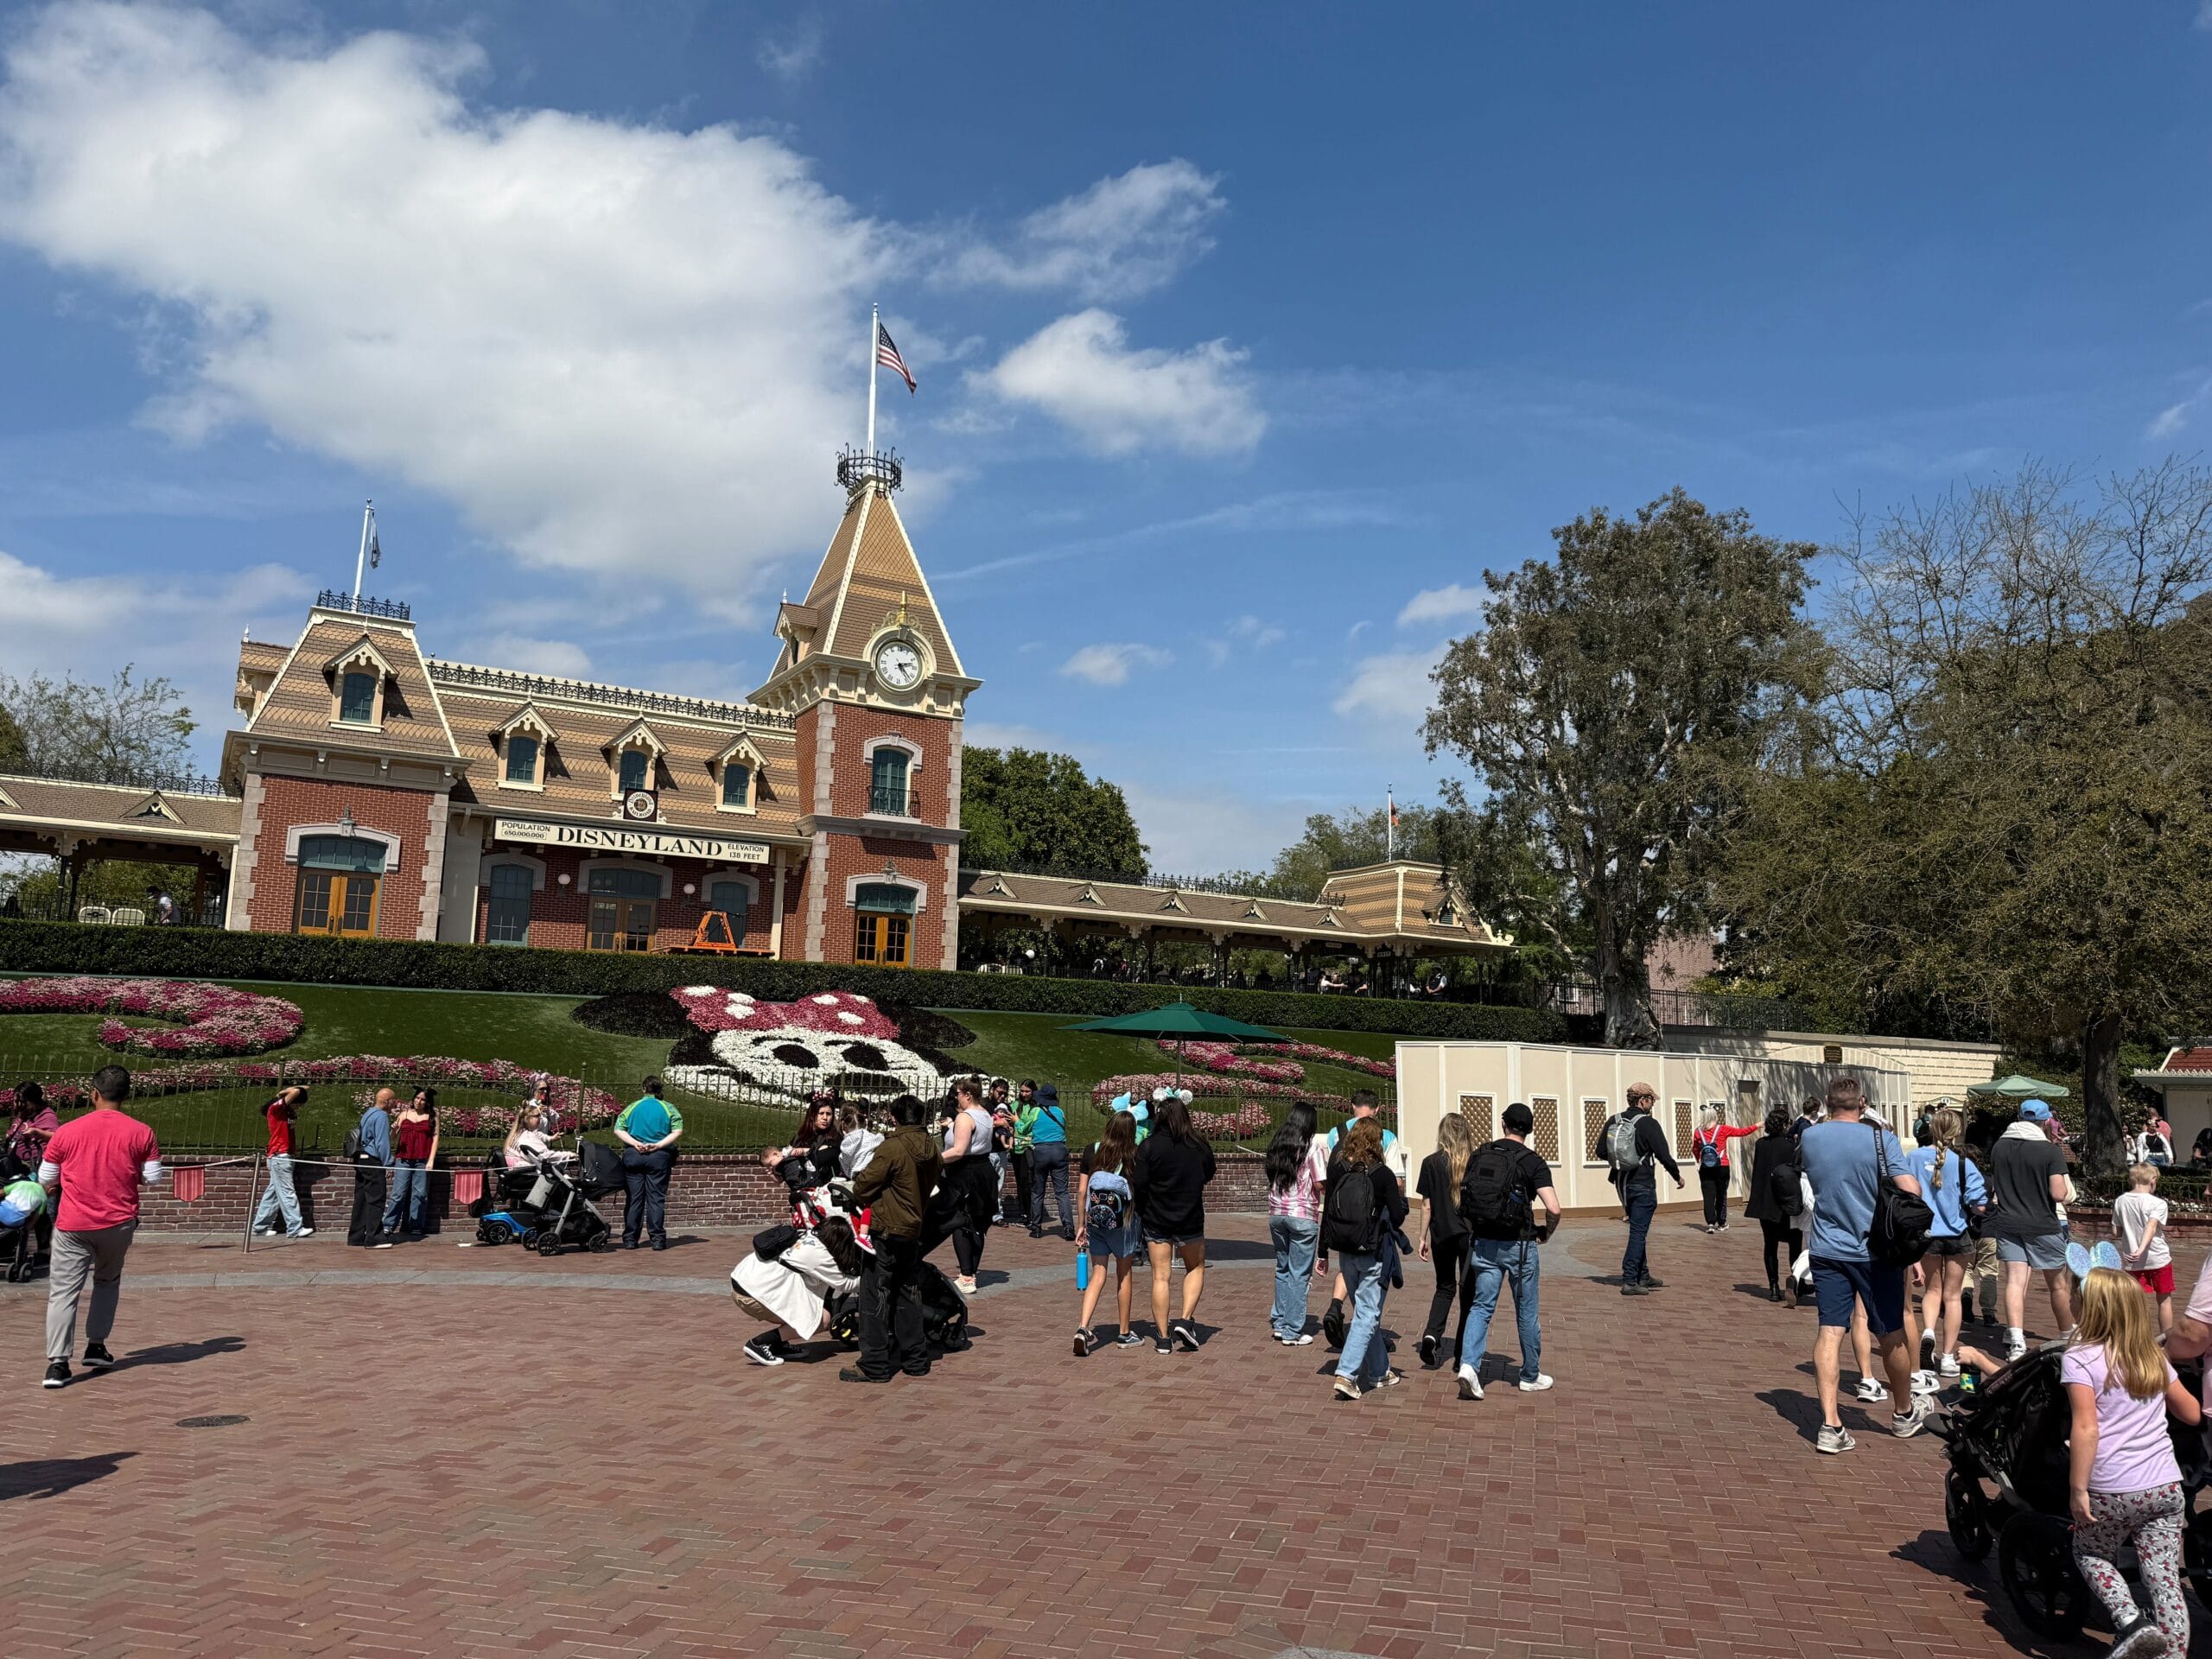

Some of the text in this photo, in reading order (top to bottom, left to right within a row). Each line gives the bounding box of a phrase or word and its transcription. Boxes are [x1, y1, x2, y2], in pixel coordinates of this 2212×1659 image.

[501, 821, 550, 832] POPULATION
[556, 827, 722, 856] DISNEYLAND
[728, 843, 764, 853] ELEVATION
[1875, 1129, 1887, 1176] UNDER ARMOUR
